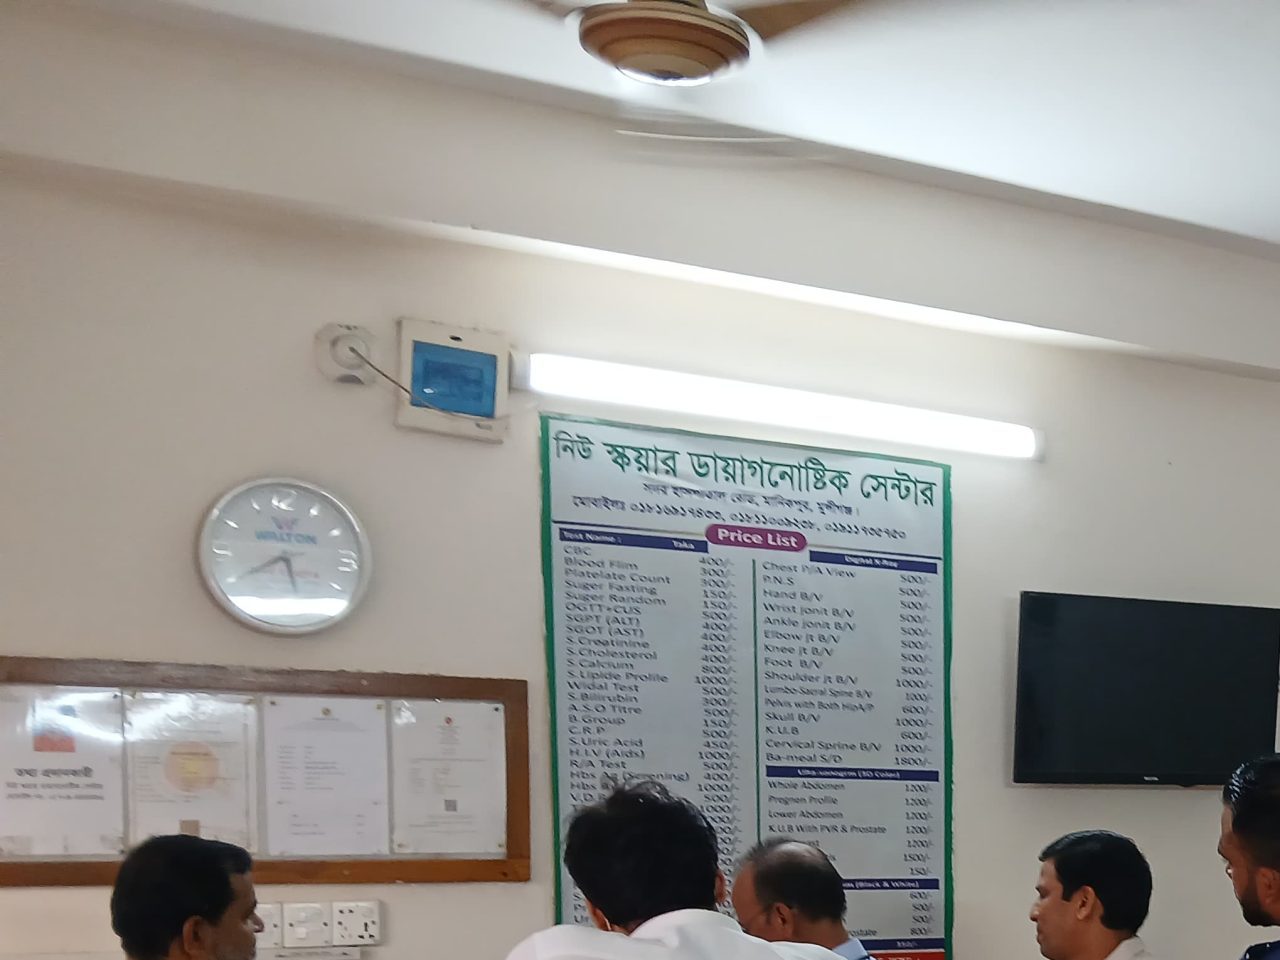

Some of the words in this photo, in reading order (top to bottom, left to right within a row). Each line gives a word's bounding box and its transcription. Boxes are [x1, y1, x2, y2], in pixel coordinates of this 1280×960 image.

[553, 430, 595, 459] নিউ
[860, 467, 937, 507] সেন্টার
[718, 528, 764, 545] Price
[767, 532, 799, 548] List
[563, 545, 592, 556] CBC
[563, 556, 605, 569] Blood
[762, 561, 798, 573] Chest
[826, 566, 857, 578] View
[630, 573, 671, 585] Count
[609, 594, 667, 606] Random
[762, 588, 797, 600] Hand
[606, 616, 641, 627] (ALT)
[764, 616, 799, 628] Ankle
[566, 625, 603, 635] SGOT
[608, 627, 644, 638] (AST)
[764, 629, 801, 641] Elbow
[764, 643, 796, 655] Knee
[764, 657, 794, 668] Foot
[625, 672, 669, 683] Profile
[764, 671, 820, 684] Shoulder
[612, 682, 640, 692] Test
[764, 711, 795, 722] Skull
[613, 738, 644, 748] Acid
[765, 739, 814, 750] Cervical
[600, 759, 627, 770] Test
[850, 825, 887, 835] Prostate
